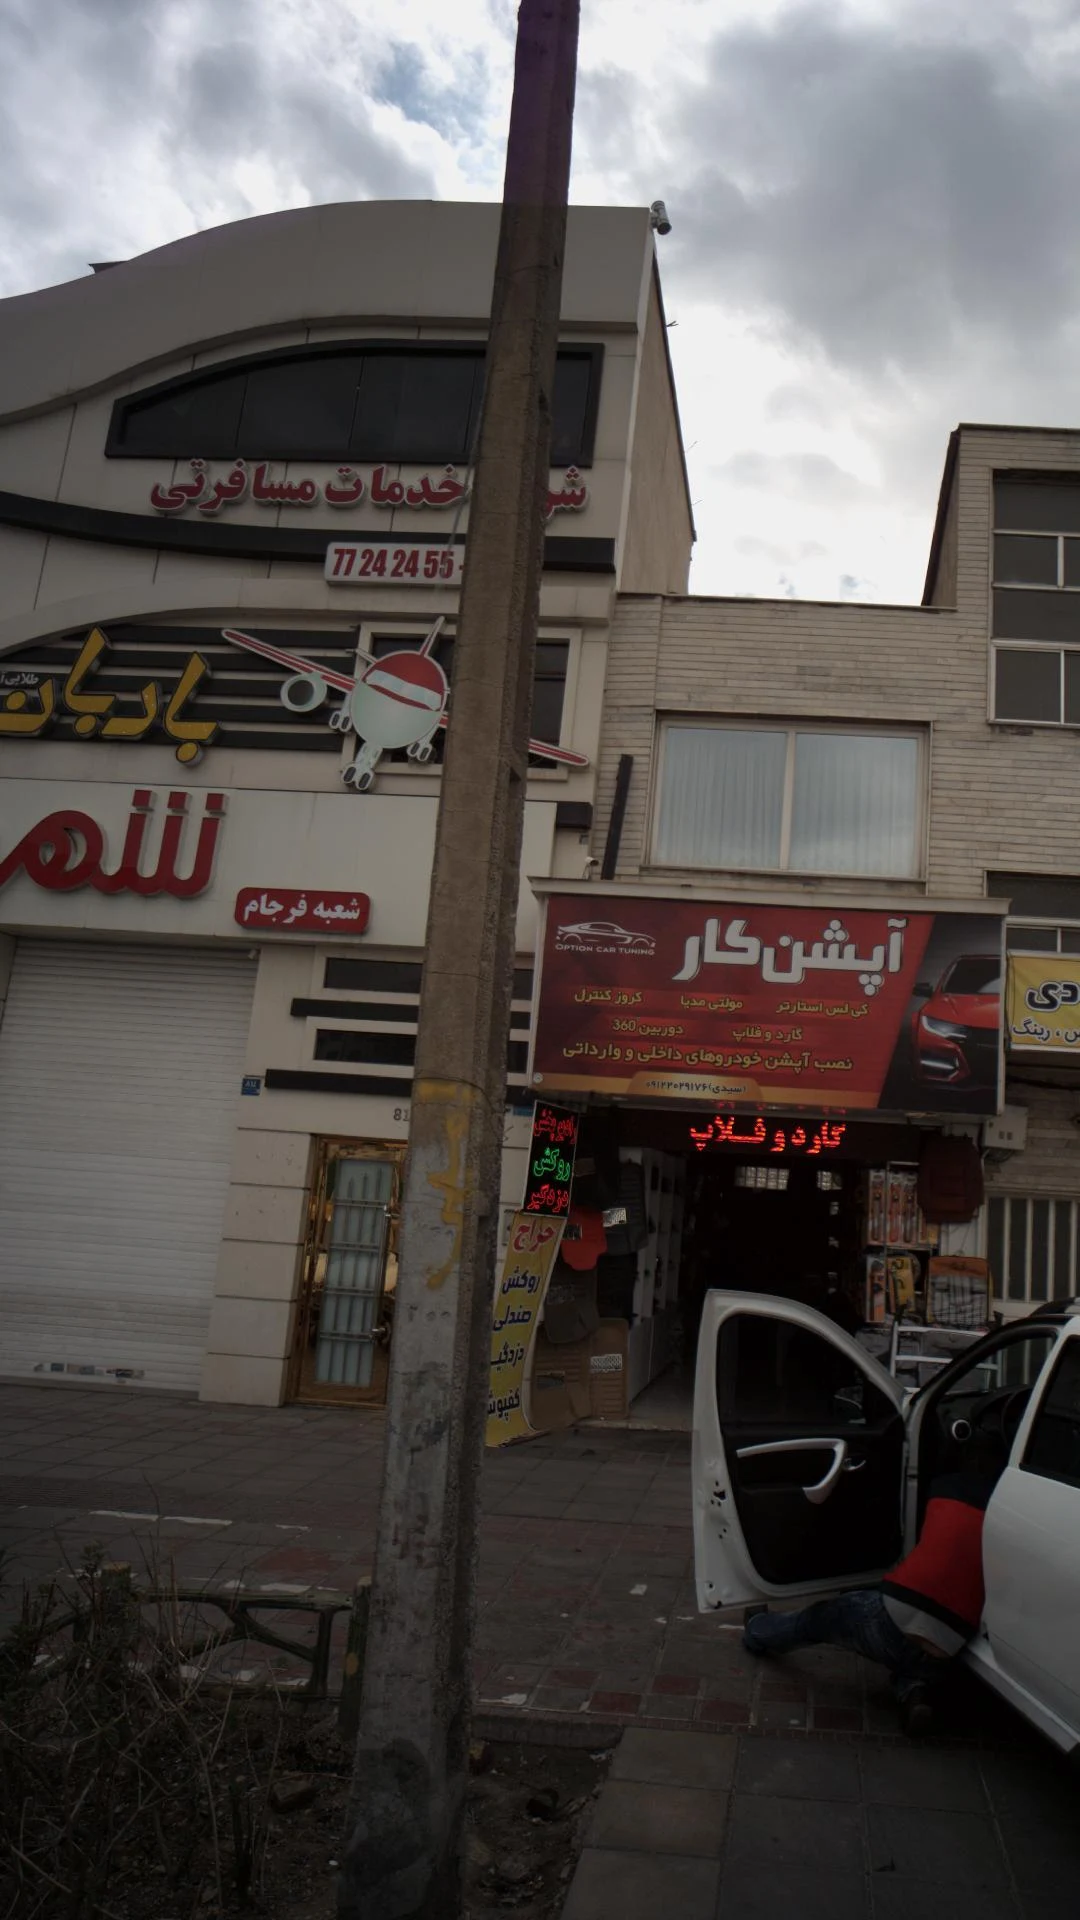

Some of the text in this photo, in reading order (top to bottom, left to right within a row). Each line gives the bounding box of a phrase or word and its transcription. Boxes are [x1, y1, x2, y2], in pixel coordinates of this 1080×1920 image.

[150, 458, 317, 512] مسافرتی
[325, 463, 467, 505] خدمات
[243, 893, 361, 924] شعبه فرجام
[555, 943, 593, 952] OPTION
[618, 947, 656, 956] TUNING
[574, 988, 642, 1005] کروز کنترل
[680, 995, 743, 1012] مولتی مدیا
[776, 1001, 822, 1014] استارتر
[851, 1003, 869, 1018] کی
[638, 1023, 684, 1036] دوربین
[732, 1025, 762, 1042] فلاپ
[765, 1031, 772, 1042] و
[1012, 1019, 1051, 1042] رینگ
[562, 1042, 853, 1074] نصب آپشن خودروهای داخلی و وارداتی
[769, 1129, 786, 1153] و
[790, 1120, 847, 1156] گارد
[533, 1147, 571, 1182] روکش
[512, 1219, 556, 1252] حراج
[502, 1265, 541, 1295] روکش
[493, 1303, 532, 1332] صندلی
[490, 1342, 525, 1371] دزدگی
